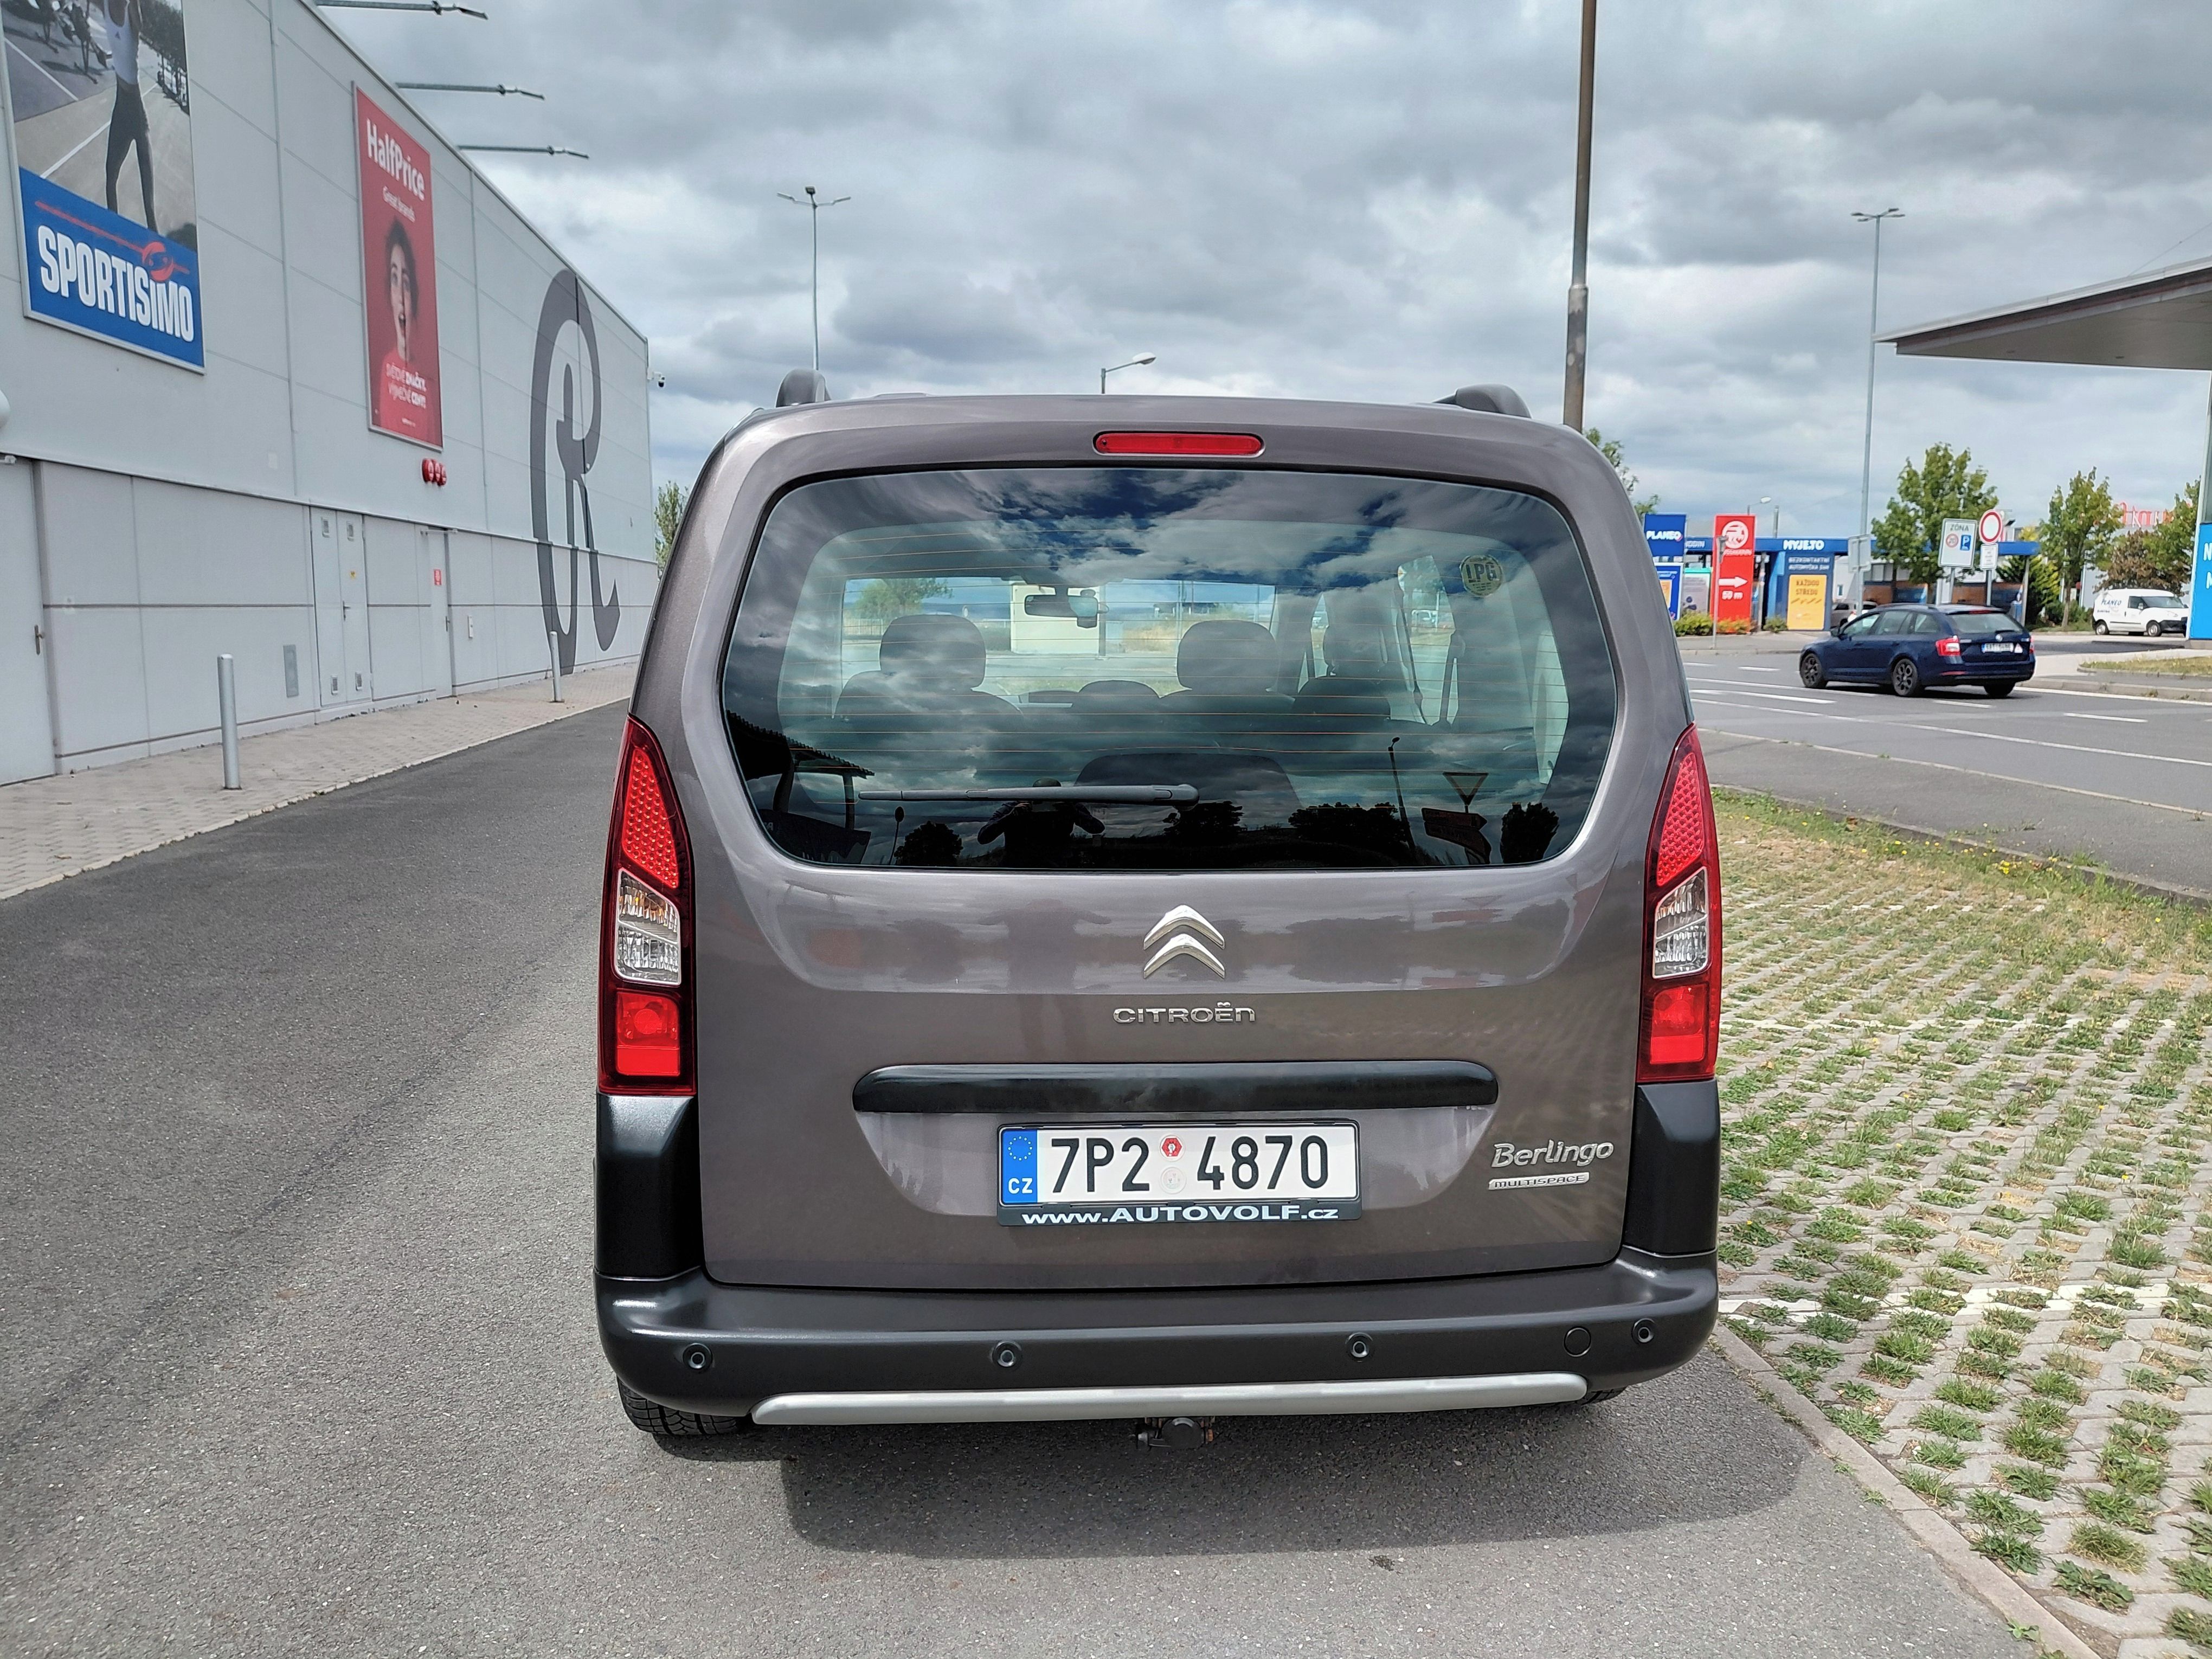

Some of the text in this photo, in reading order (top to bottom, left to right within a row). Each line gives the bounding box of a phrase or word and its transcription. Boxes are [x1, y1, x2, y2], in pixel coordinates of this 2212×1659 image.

[367, 117, 425, 201] HalfPrice
[38, 225, 194, 342] SPORTISIMO
[1465, 562, 1497, 583] LPG
[1051, 1135, 1329, 1193] 7P2 4870
[1491, 1140, 1614, 1167] Berlingo
[1008, 1178, 1033, 1194] CZ
[1494, 1175, 1585, 1188] MULTISPACE
[1021, 1205, 1339, 1224] www.AUTOVOLF.cz
